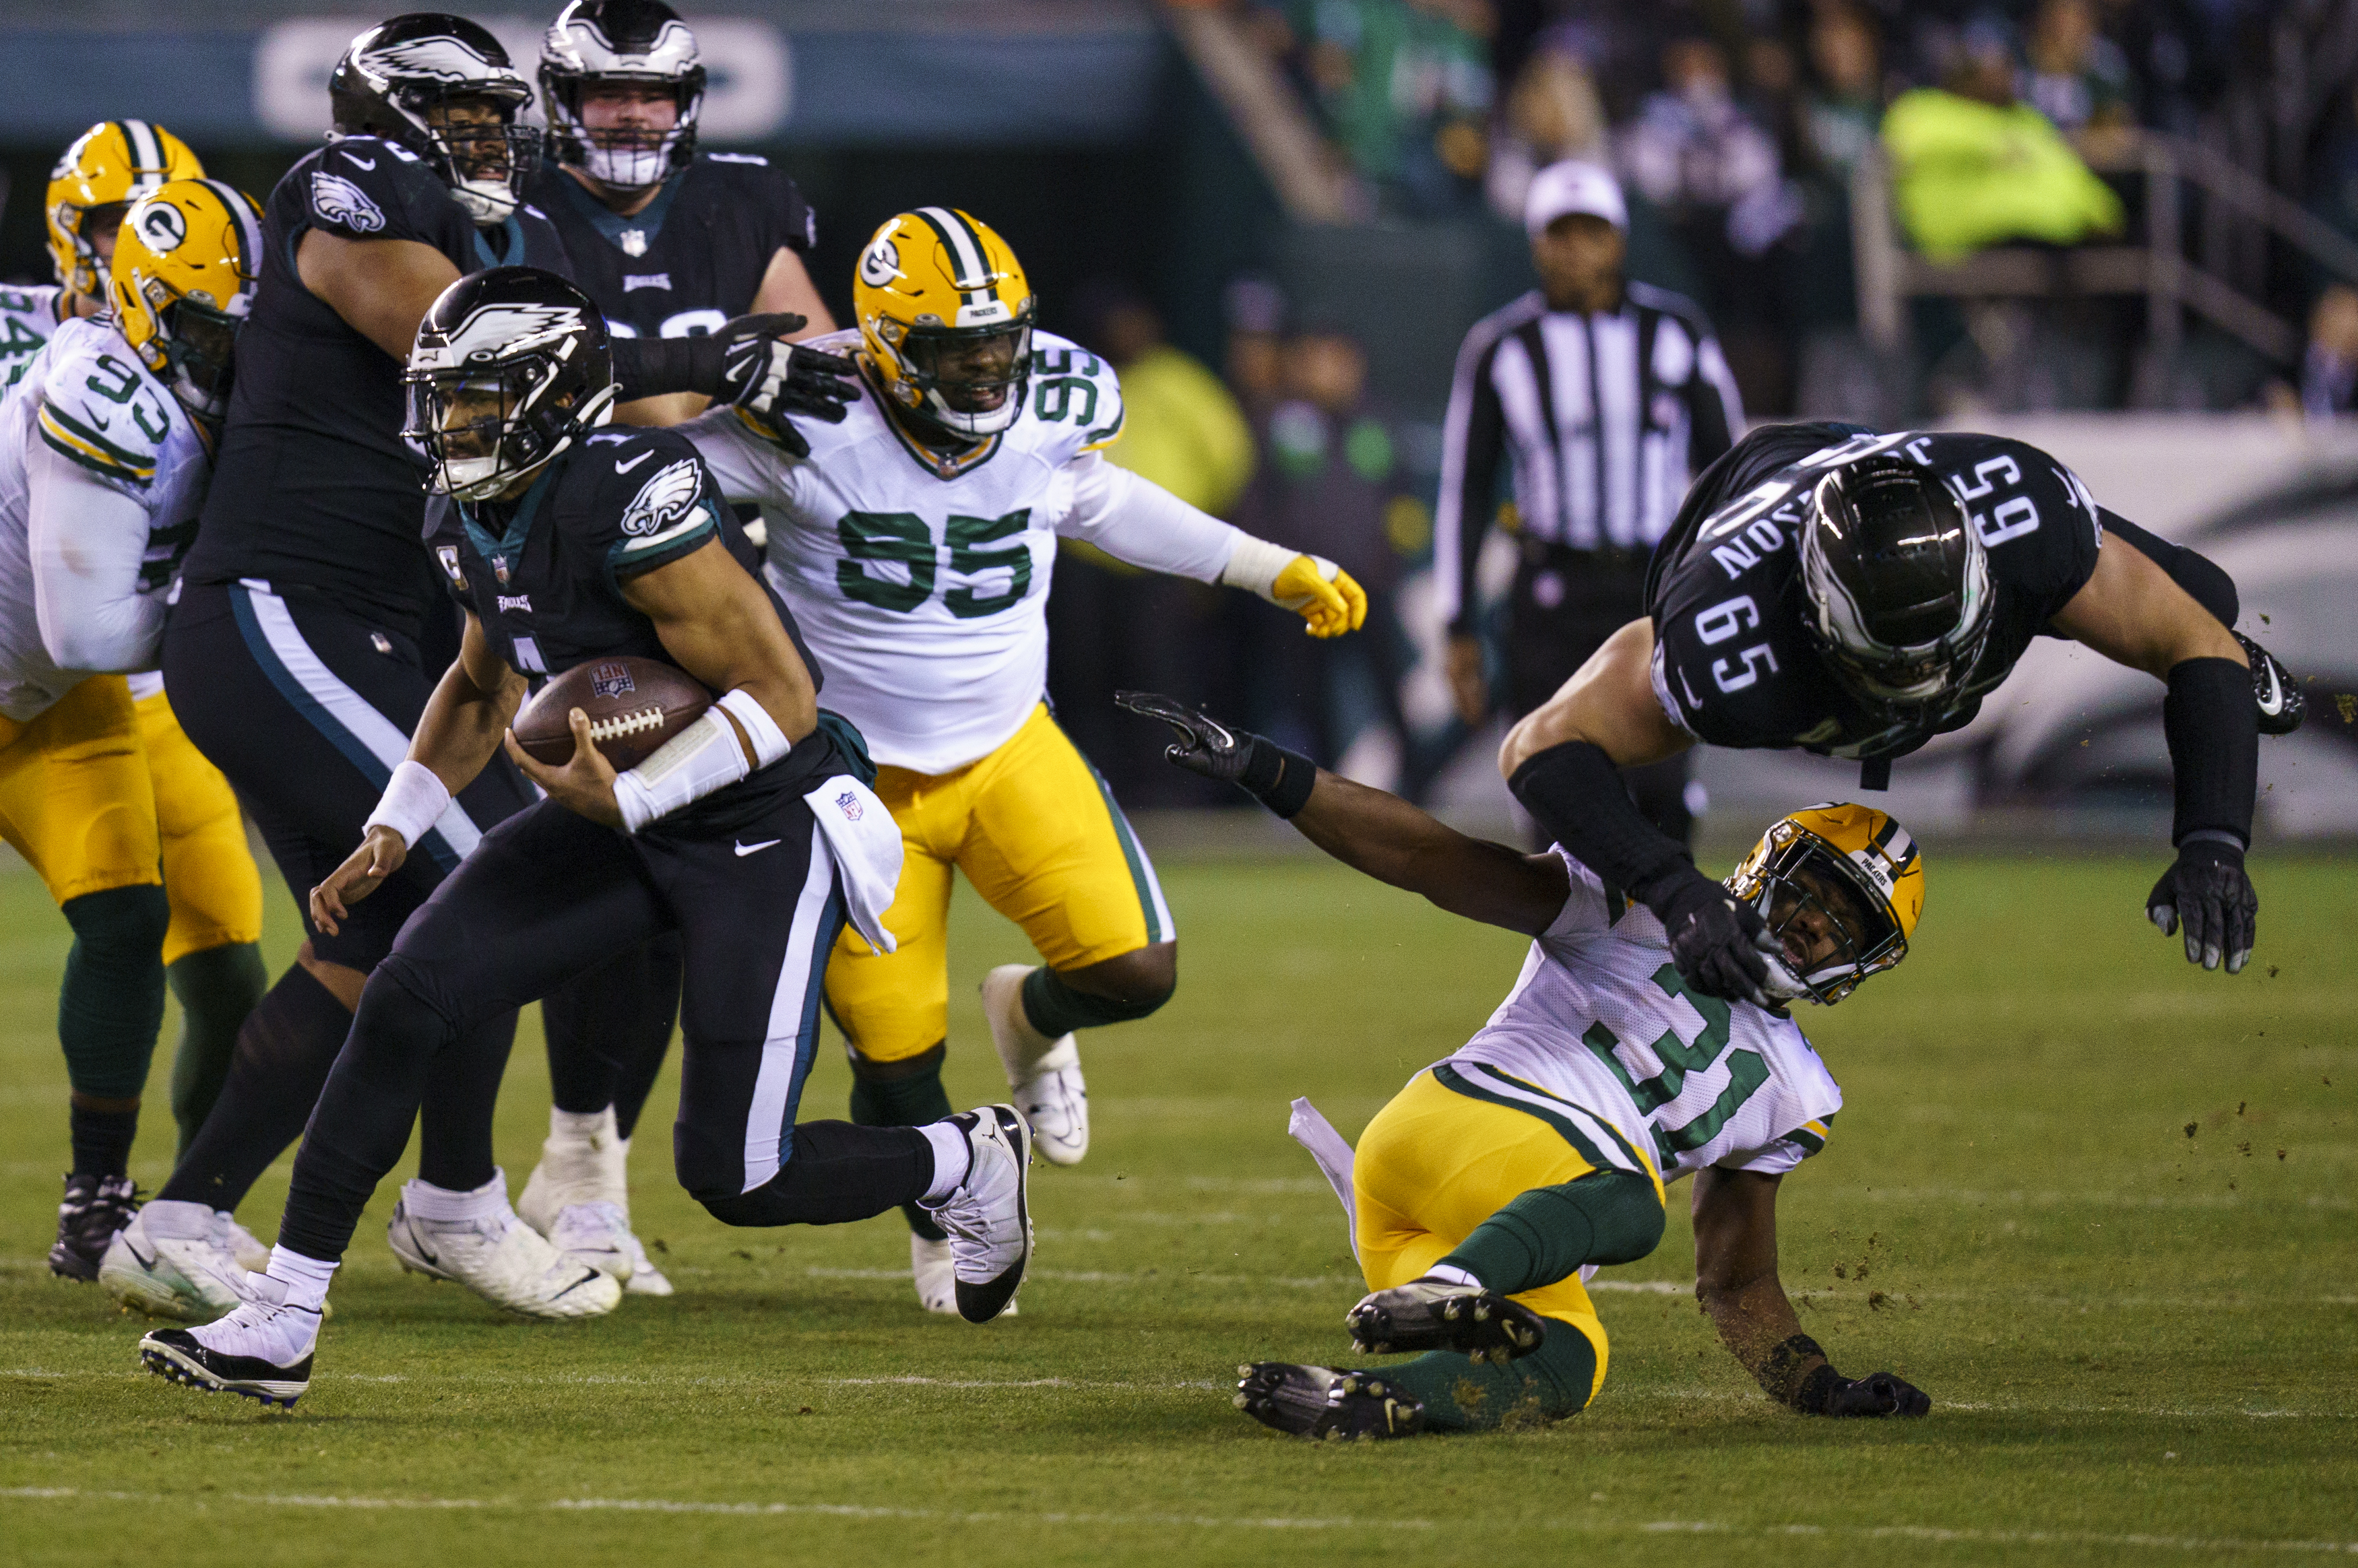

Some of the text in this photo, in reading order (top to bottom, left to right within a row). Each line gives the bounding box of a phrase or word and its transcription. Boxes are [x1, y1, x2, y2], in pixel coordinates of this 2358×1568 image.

[86, 354, 170, 445] 93
[1951, 454, 2040, 548] 65
[837, 507, 1032, 619] 95
[593, 663, 625, 682] NFL
[1695, 594, 1779, 694] 65
[842, 802, 862, 819] NFL
[1861, 857, 1887, 886] PACKERS
[1582, 962, 1771, 1170] 31
